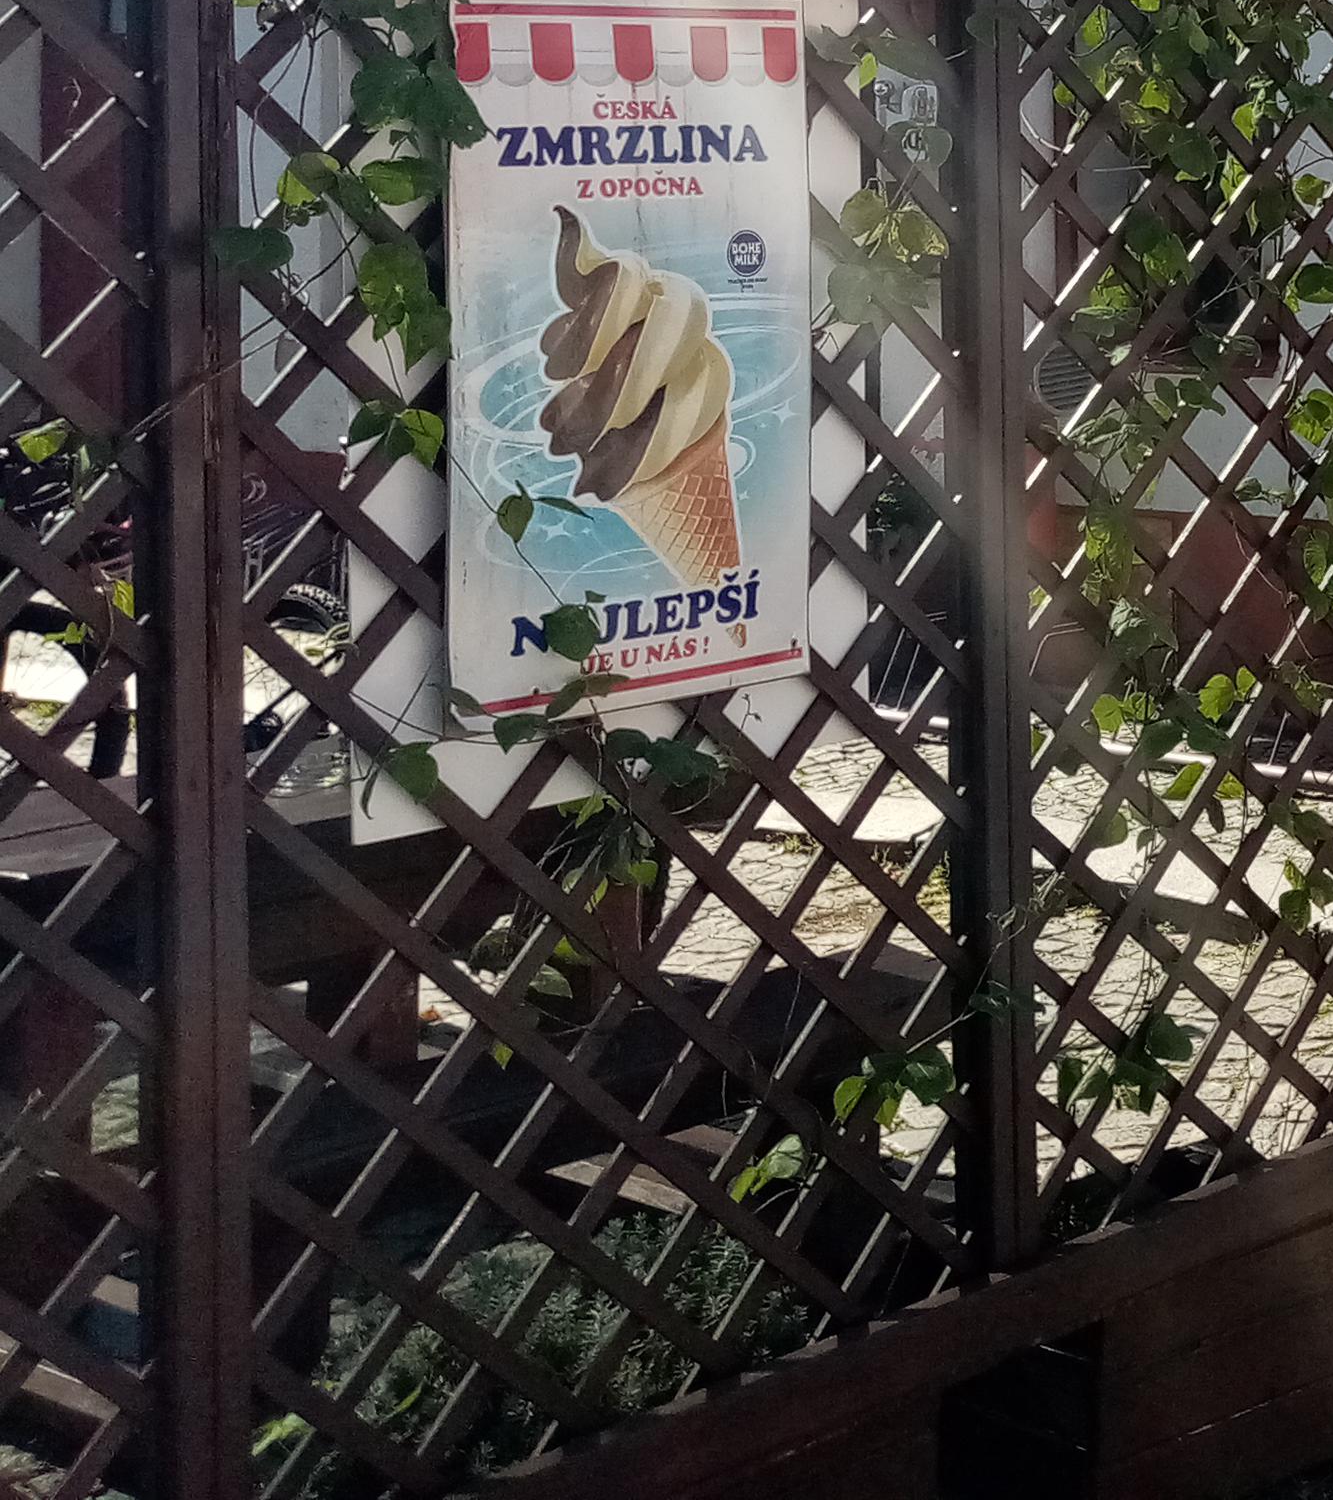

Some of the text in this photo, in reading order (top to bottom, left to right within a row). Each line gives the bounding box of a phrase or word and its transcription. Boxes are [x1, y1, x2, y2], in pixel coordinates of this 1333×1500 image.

[592, 93, 678, 120] ČESKÁ
[497, 124, 768, 167] ZMRZLINA
[577, 170, 704, 199] Z OPOČNA
[734, 253, 760, 267] MILK
[510, 569, 762, 657] NJLEPŠÍ
[580, 651, 614, 675] JE
[620, 647, 639, 668] U
[645, 635, 698, 665] NÁS
